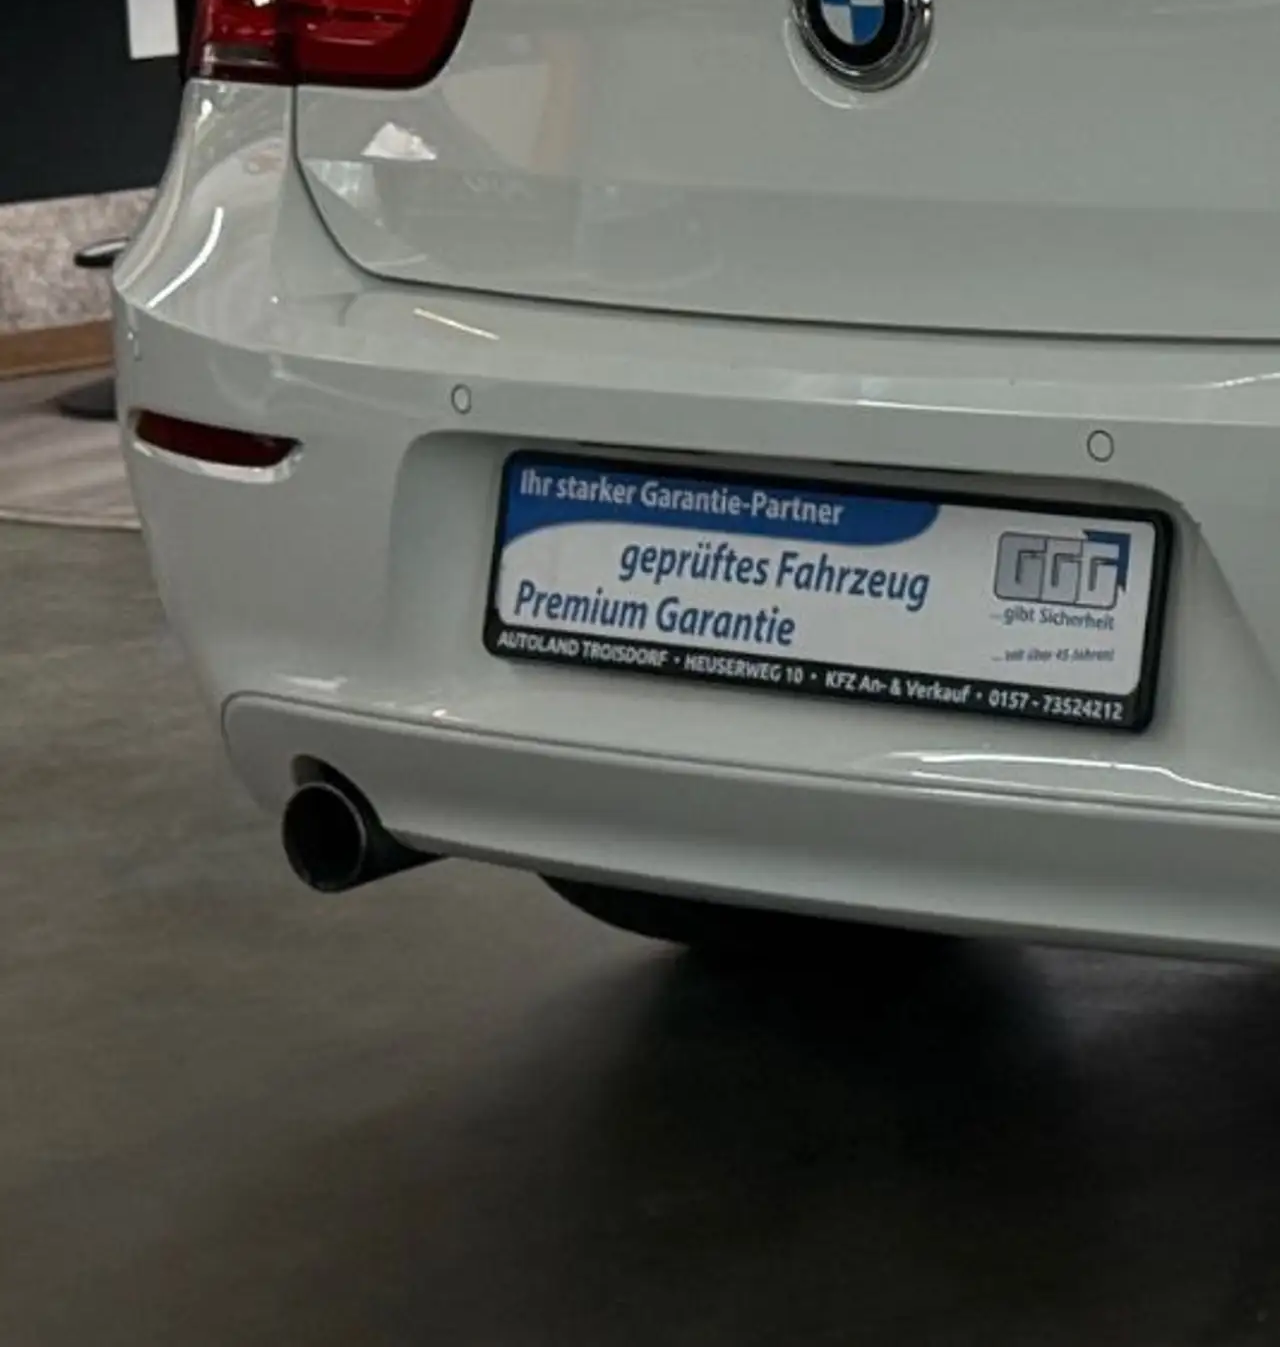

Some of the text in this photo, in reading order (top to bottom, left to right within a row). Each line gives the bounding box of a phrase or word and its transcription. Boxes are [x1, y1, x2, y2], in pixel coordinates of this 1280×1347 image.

[520, 468, 845, 527] Ihr starker Garantie-Partner
[618, 540, 931, 612] geprüftes Fahrzeug
[513, 578, 796, 647] Premium Garantie
[1038, 607, 1115, 631] Sicherheit
[496, 630, 580, 657] AUTOLAND
[581, 640, 669, 668] TROISDORF
[683, 653, 783, 683] HEUSERWEG
[785, 666, 804, 684] 10
[824, 670, 857, 692] KFZ
[889, 677, 902, 697] &
[905, 679, 972, 704] Verkauf
[987, 689, 1030, 710] 0157
